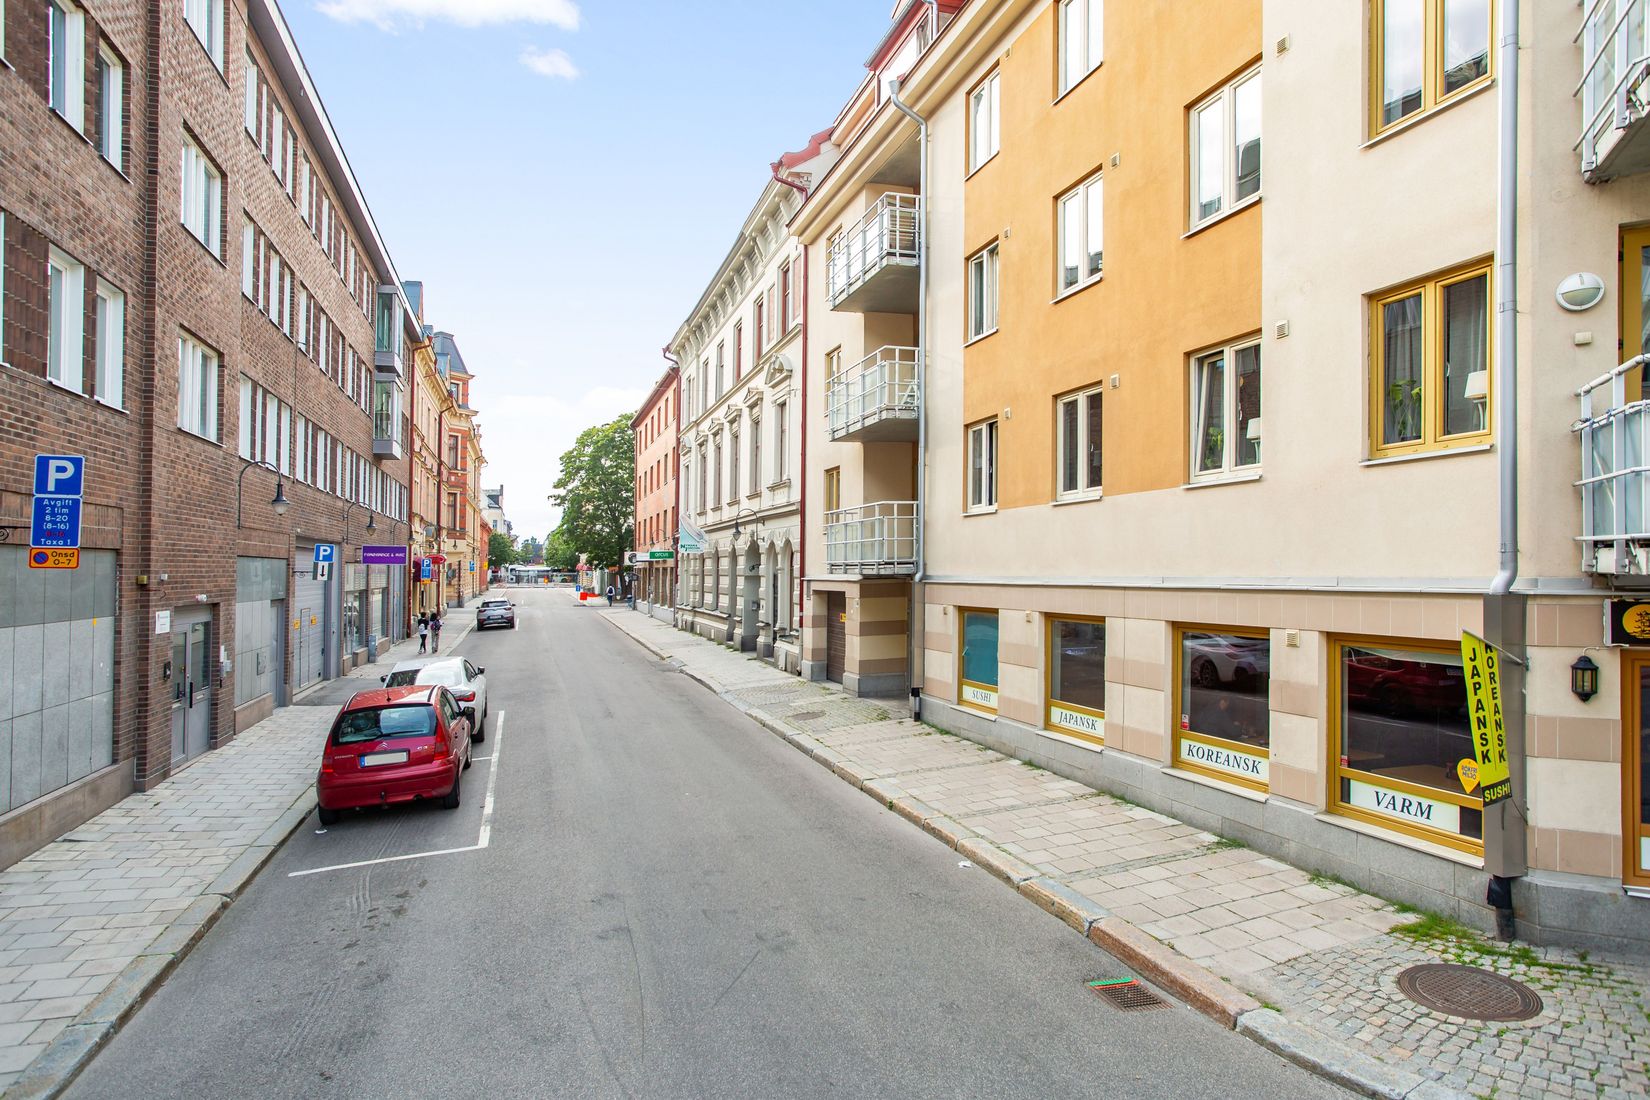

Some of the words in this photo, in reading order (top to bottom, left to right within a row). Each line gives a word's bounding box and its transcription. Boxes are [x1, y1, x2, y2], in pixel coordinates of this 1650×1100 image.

[48, 460, 75, 491] P
[319, 546, 331, 561] P
[423, 559, 430, 567] P
[972, 689, 992, 703] SUSHI
[1469, 647, 1492, 765] JAPANSK
[1484, 643, 1506, 763] KOREANSK
[1059, 711, 1097, 731] JAPANSK
[1187, 744, 1261, 774] KOREANSK
[1484, 782, 1511, 802] SUSHI
[1374, 790, 1434, 821] VARM
